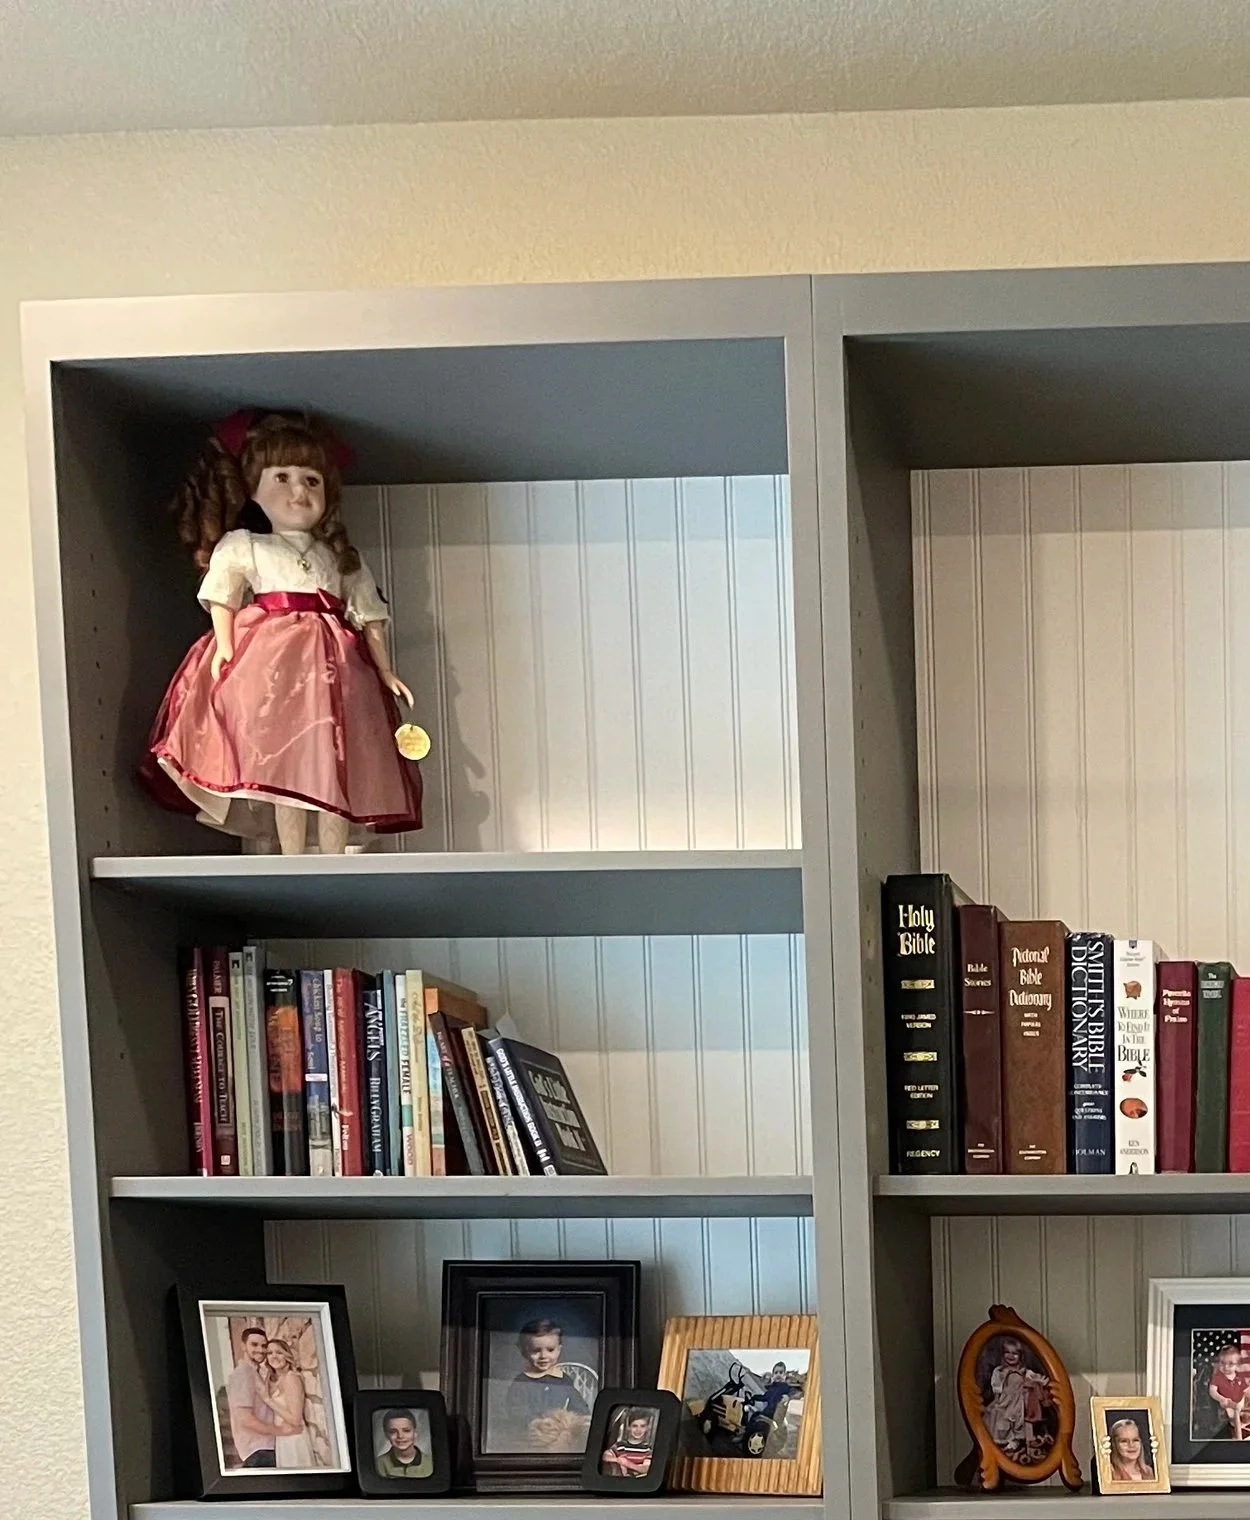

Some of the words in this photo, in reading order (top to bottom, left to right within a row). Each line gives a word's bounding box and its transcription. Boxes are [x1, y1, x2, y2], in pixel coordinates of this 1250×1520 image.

[898, 904, 936, 932] Holy
[898, 932, 936, 956] Bible
[967, 963, 989, 973] Bible
[1019, 967, 1043, 986] Bible
[1088, 940, 1105, 1018] SMITH'S
[964, 977, 992, 987] Stories
[1008, 989, 1053, 1012] Dictionary
[1071, 946, 1088, 1072] DICTIONARY
[1172, 1007, 1180, 1015] of
[1117, 1006, 1150, 1019] WHERE
[1164, 1015, 1188, 1023] Praise
[364, 1002, 382, 1061] ANGELS
[1126, 1020, 1143, 1033] FIND
[1088, 1022, 1105, 1074] BIBLE
[1132, 1034, 1146, 1045] THE
[216, 1031, 226, 1073] COURAGE
[1117, 1044, 1151, 1062] BIBLE
[401, 1059, 412, 1095] FEMALE
[904, 1084, 917, 1092] RED
[918, 1084, 939, 1092] LETTER
[219, 1093, 229, 1122] TEACH
[511, 1084, 533, 1123] INSTRUCTION
[527, 1121, 541, 1140] BOOK
[371, 1106, 383, 1153] GRAHAM
[405, 1133, 414, 1166] WOOD
[1128, 1139, 1140, 1147] KEN
